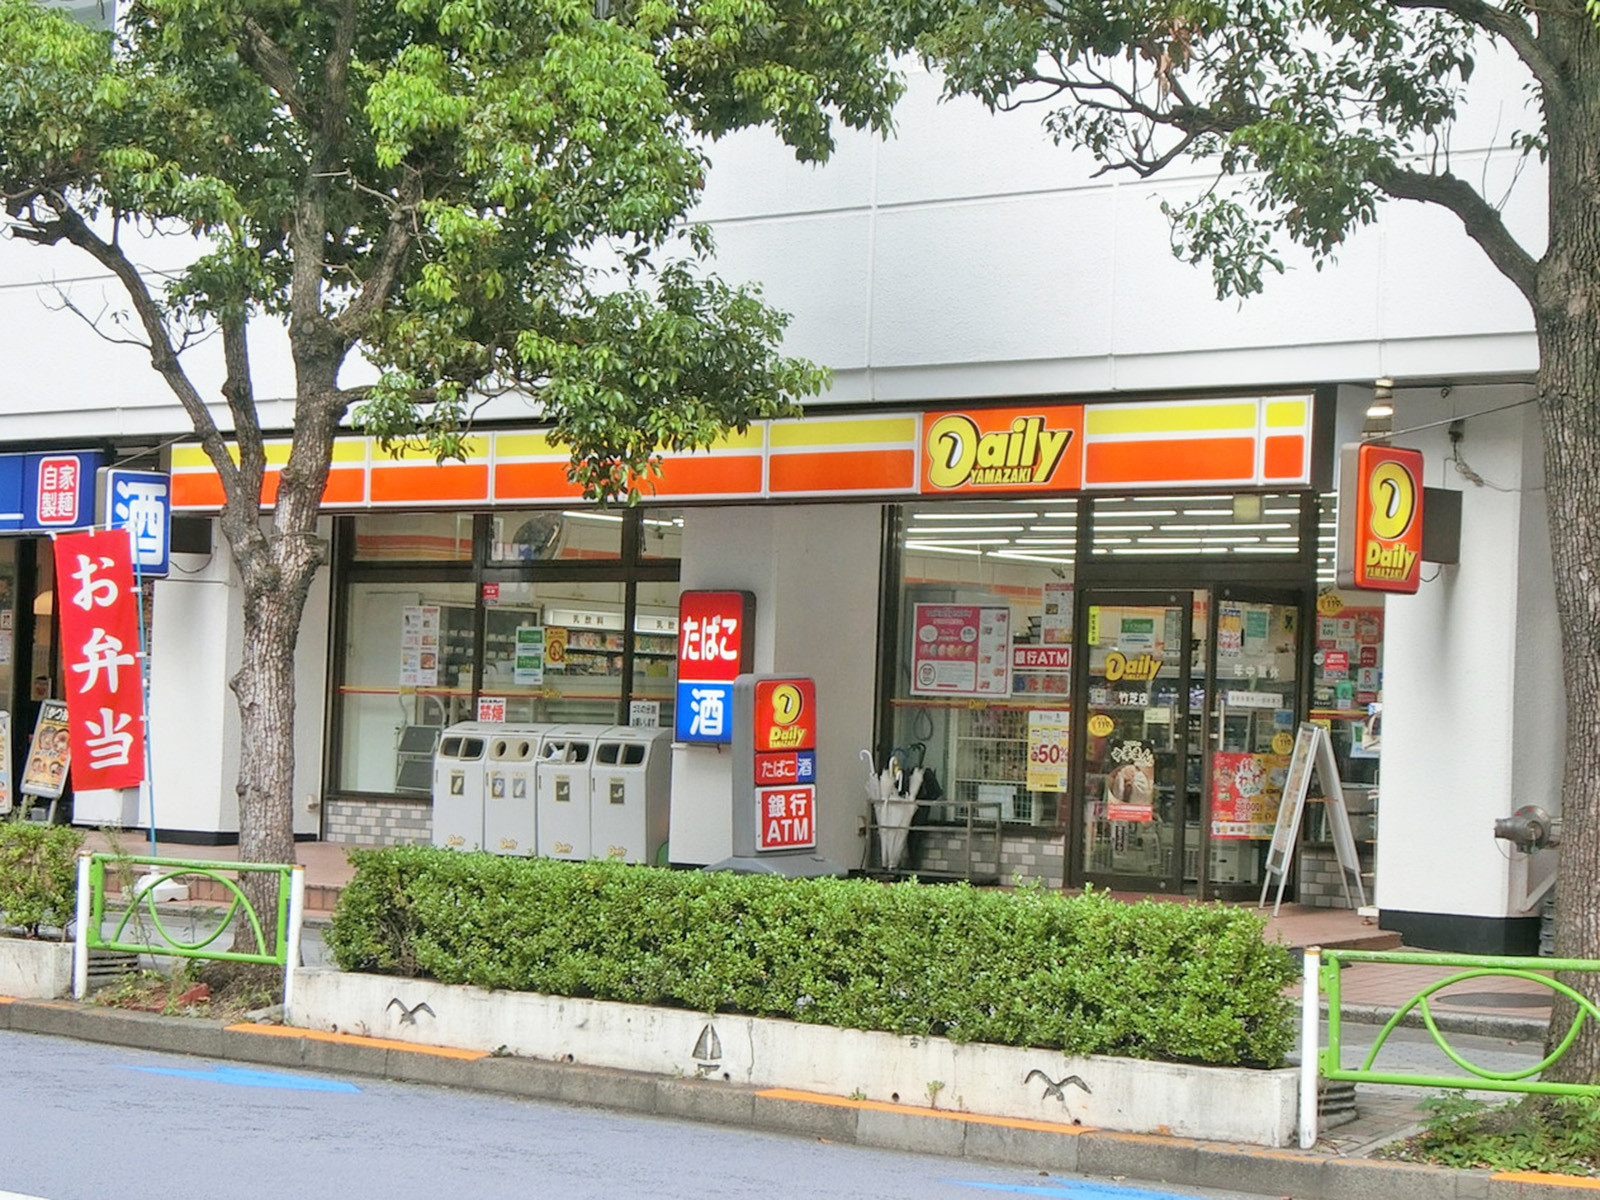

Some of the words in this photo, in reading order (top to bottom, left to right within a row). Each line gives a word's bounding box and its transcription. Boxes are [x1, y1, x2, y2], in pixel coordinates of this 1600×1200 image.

[928, 415, 1073, 488] Daily
[43, 465, 75, 490] 自家
[970, 468, 1032, 484] YAMAZAKI
[41, 491, 74, 517] 製麺
[116, 481, 167, 565] 酒
[1367, 541, 1417, 580] Daily
[682, 615, 737, 660] たばこ
[72, 554, 135, 770] お弁当
[1015, 651, 1068, 664] 銀行ATM
[1105, 652, 1163, 681] Daily
[690, 688, 725, 735] 酒
[769, 726, 807, 748] Daily
[761, 759, 796, 778] たばこ
[798, 758, 813, 776] 酒
[768, 793, 807, 818] 銀行
[767, 818, 808, 843] ATM
